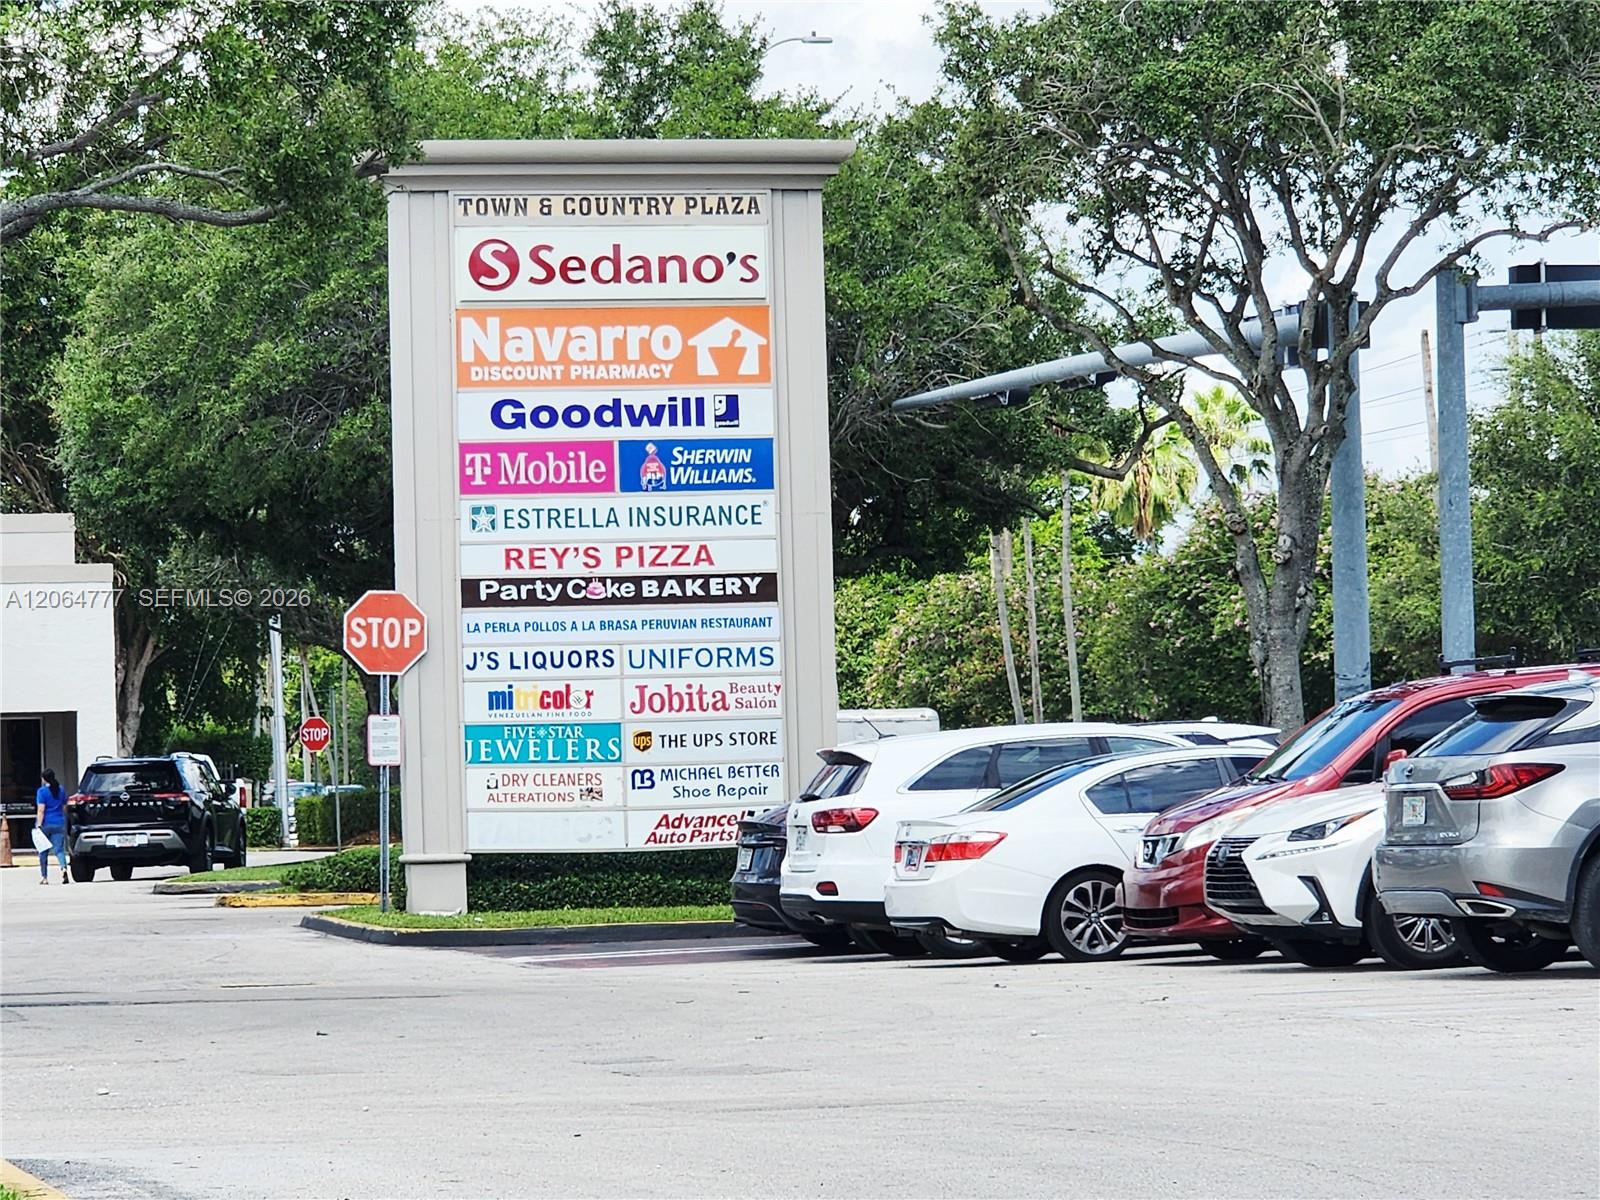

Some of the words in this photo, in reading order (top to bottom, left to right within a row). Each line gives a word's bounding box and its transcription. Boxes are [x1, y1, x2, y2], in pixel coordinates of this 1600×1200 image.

[458, 197, 528, 217] TOWN
[539, 197, 553, 216] &
[563, 196, 676, 216] COUNTRY
[684, 196, 761, 216] PLAZA
[528, 243, 760, 285] Sedano's
[460, 316, 683, 363] Navarro
[470, 365, 564, 382] DISCOUNT
[570, 363, 674, 380] PHARMACY
[490, 396, 706, 430] Goodwill
[671, 446, 752, 466] SHERWIN
[465, 452, 491, 486] T
[497, 450, 607, 486] Mobile
[503, 507, 620, 529] ESTRELLA
[504, 546, 602, 571] REY'S
[615, 544, 715, 569] PIZZA
[479, 580, 562, 602] Party
[566, 578, 636, 600] Cke
[642, 576, 763, 598] BAKERY
[350, 617, 422, 649] STOP
[466, 622, 481, 634] LA
[484, 622, 521, 633] PERLA
[524, 620, 567, 632] POLLOS
[570, 620, 580, 632] A
[582, 620, 596, 631] LA
[599, 619, 638, 631] BRASA
[641, 617, 697, 630] PERUVIAN
[701, 616, 774, 630] RESTAURANT
[465, 650, 500, 672] J'S
[509, 648, 615, 670] LIQUORS
[628, 646, 775, 669] UNIFORMS
[629, 683, 731, 715] Jobita
[729, 682, 782, 697] Beauty
[735, 696, 777, 710] Salón
[488, 711, 542, 719] VENEZUELAN
[302, 726, 328, 742] STOP
[503, 726, 536, 739] FIVE
[549, 725, 585, 738] STAR
[633, 735, 652, 750] ups
[658, 733, 687, 749] THE
[693, 732, 724, 748] UPS
[729, 731, 777, 746] STORE
[465, 736, 620, 764] JEWELERS
[501, 773, 529, 787] DRY
[533, 772, 603, 787] CLEANERS
[660, 767, 723, 782] MICHAEL
[728, 764, 780, 779] BETTER
[487, 791, 575, 803] ALTERATIONS
[672, 785, 711, 799] Shoe
[717, 782, 769, 800] Repair
[654, 812, 738, 831] Advance
[644, 831, 687, 845] Auto
[689, 829, 734, 843] Parts
